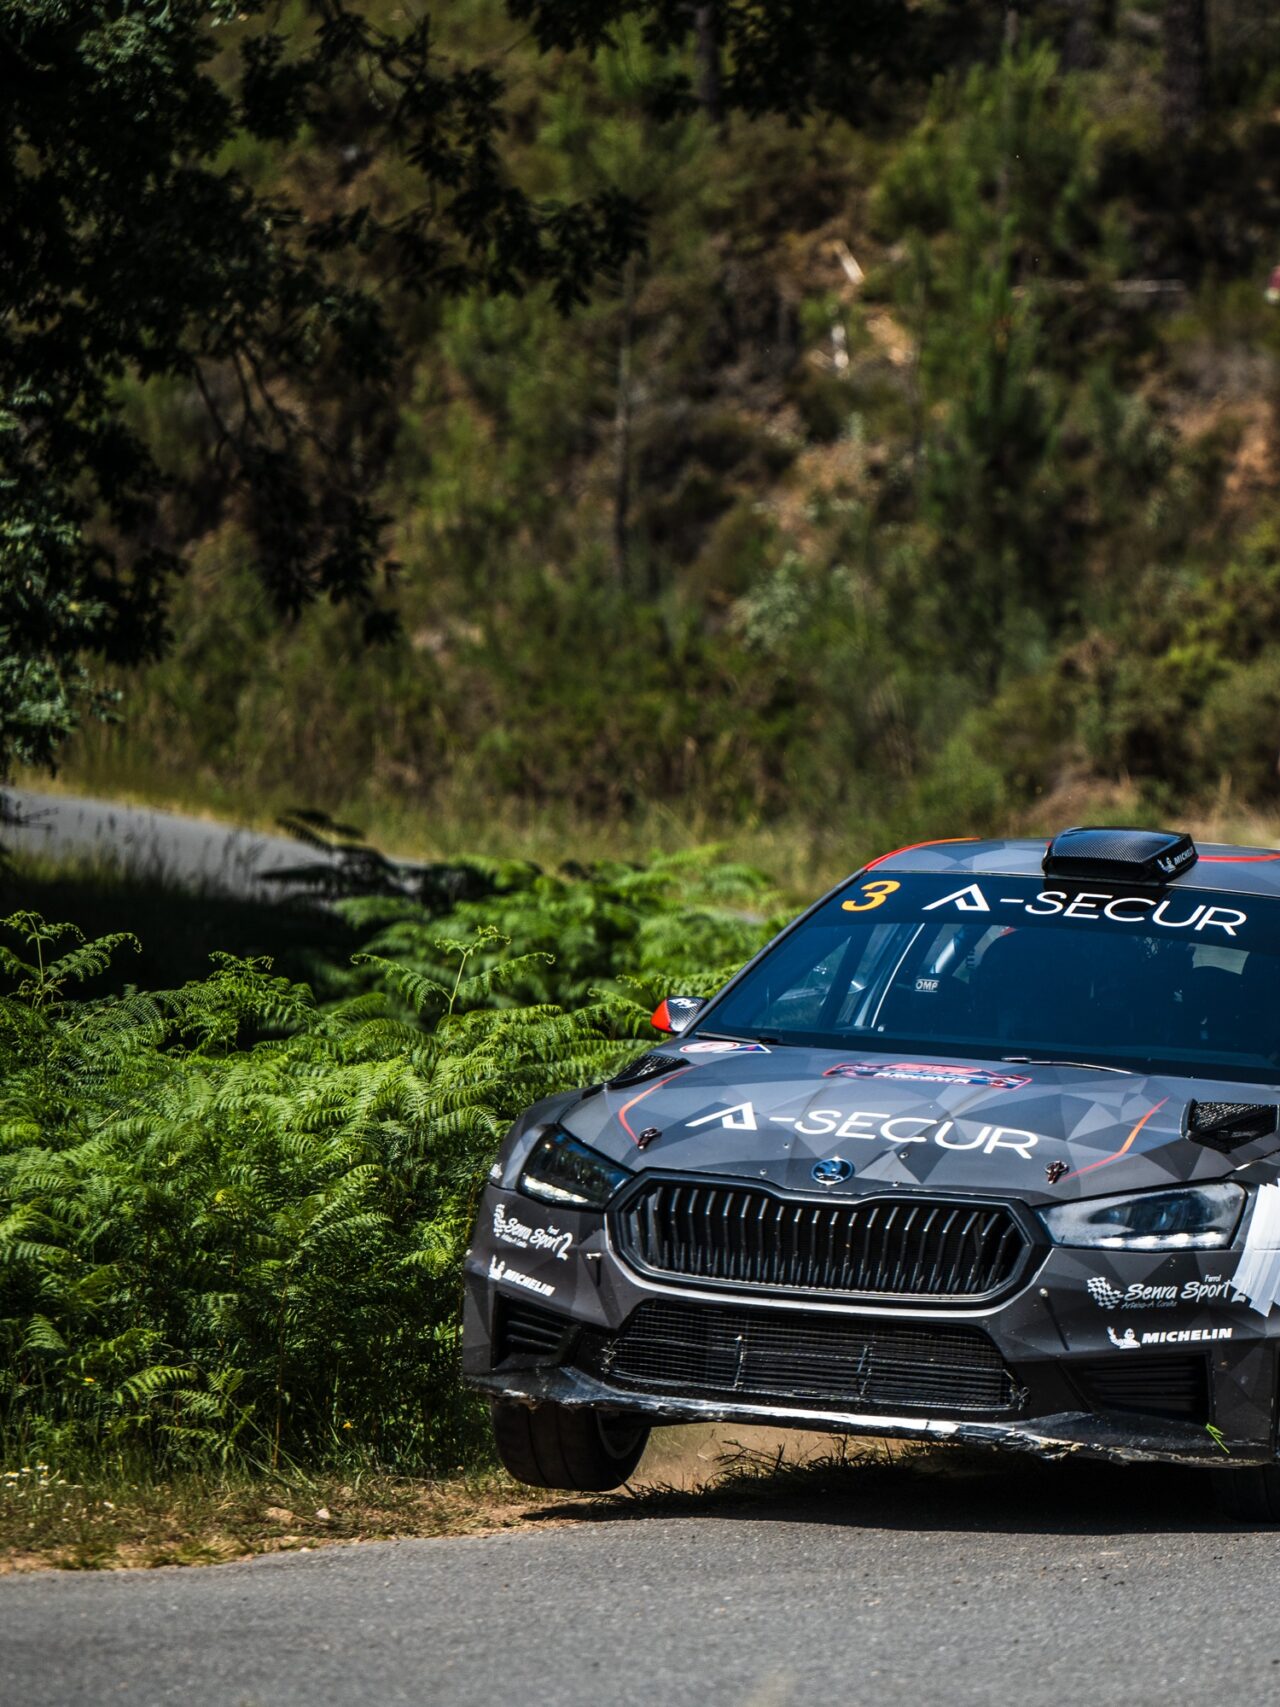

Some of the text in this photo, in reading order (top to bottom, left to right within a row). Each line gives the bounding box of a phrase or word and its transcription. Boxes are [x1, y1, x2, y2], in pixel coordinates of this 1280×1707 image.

[841, 880, 901, 912] 3
[921, 883, 1248, 937] A-SECUR
[915, 979, 939, 991] OMP
[685, 1101, 1039, 1160] A-SECUR
[502, 1268, 556, 1297] MICHELIN
[1123, 1283, 1179, 1301] Senra
[1180, 1279, 1233, 1303] Sport
[1141, 1327, 1233, 1344] MICHELIN
